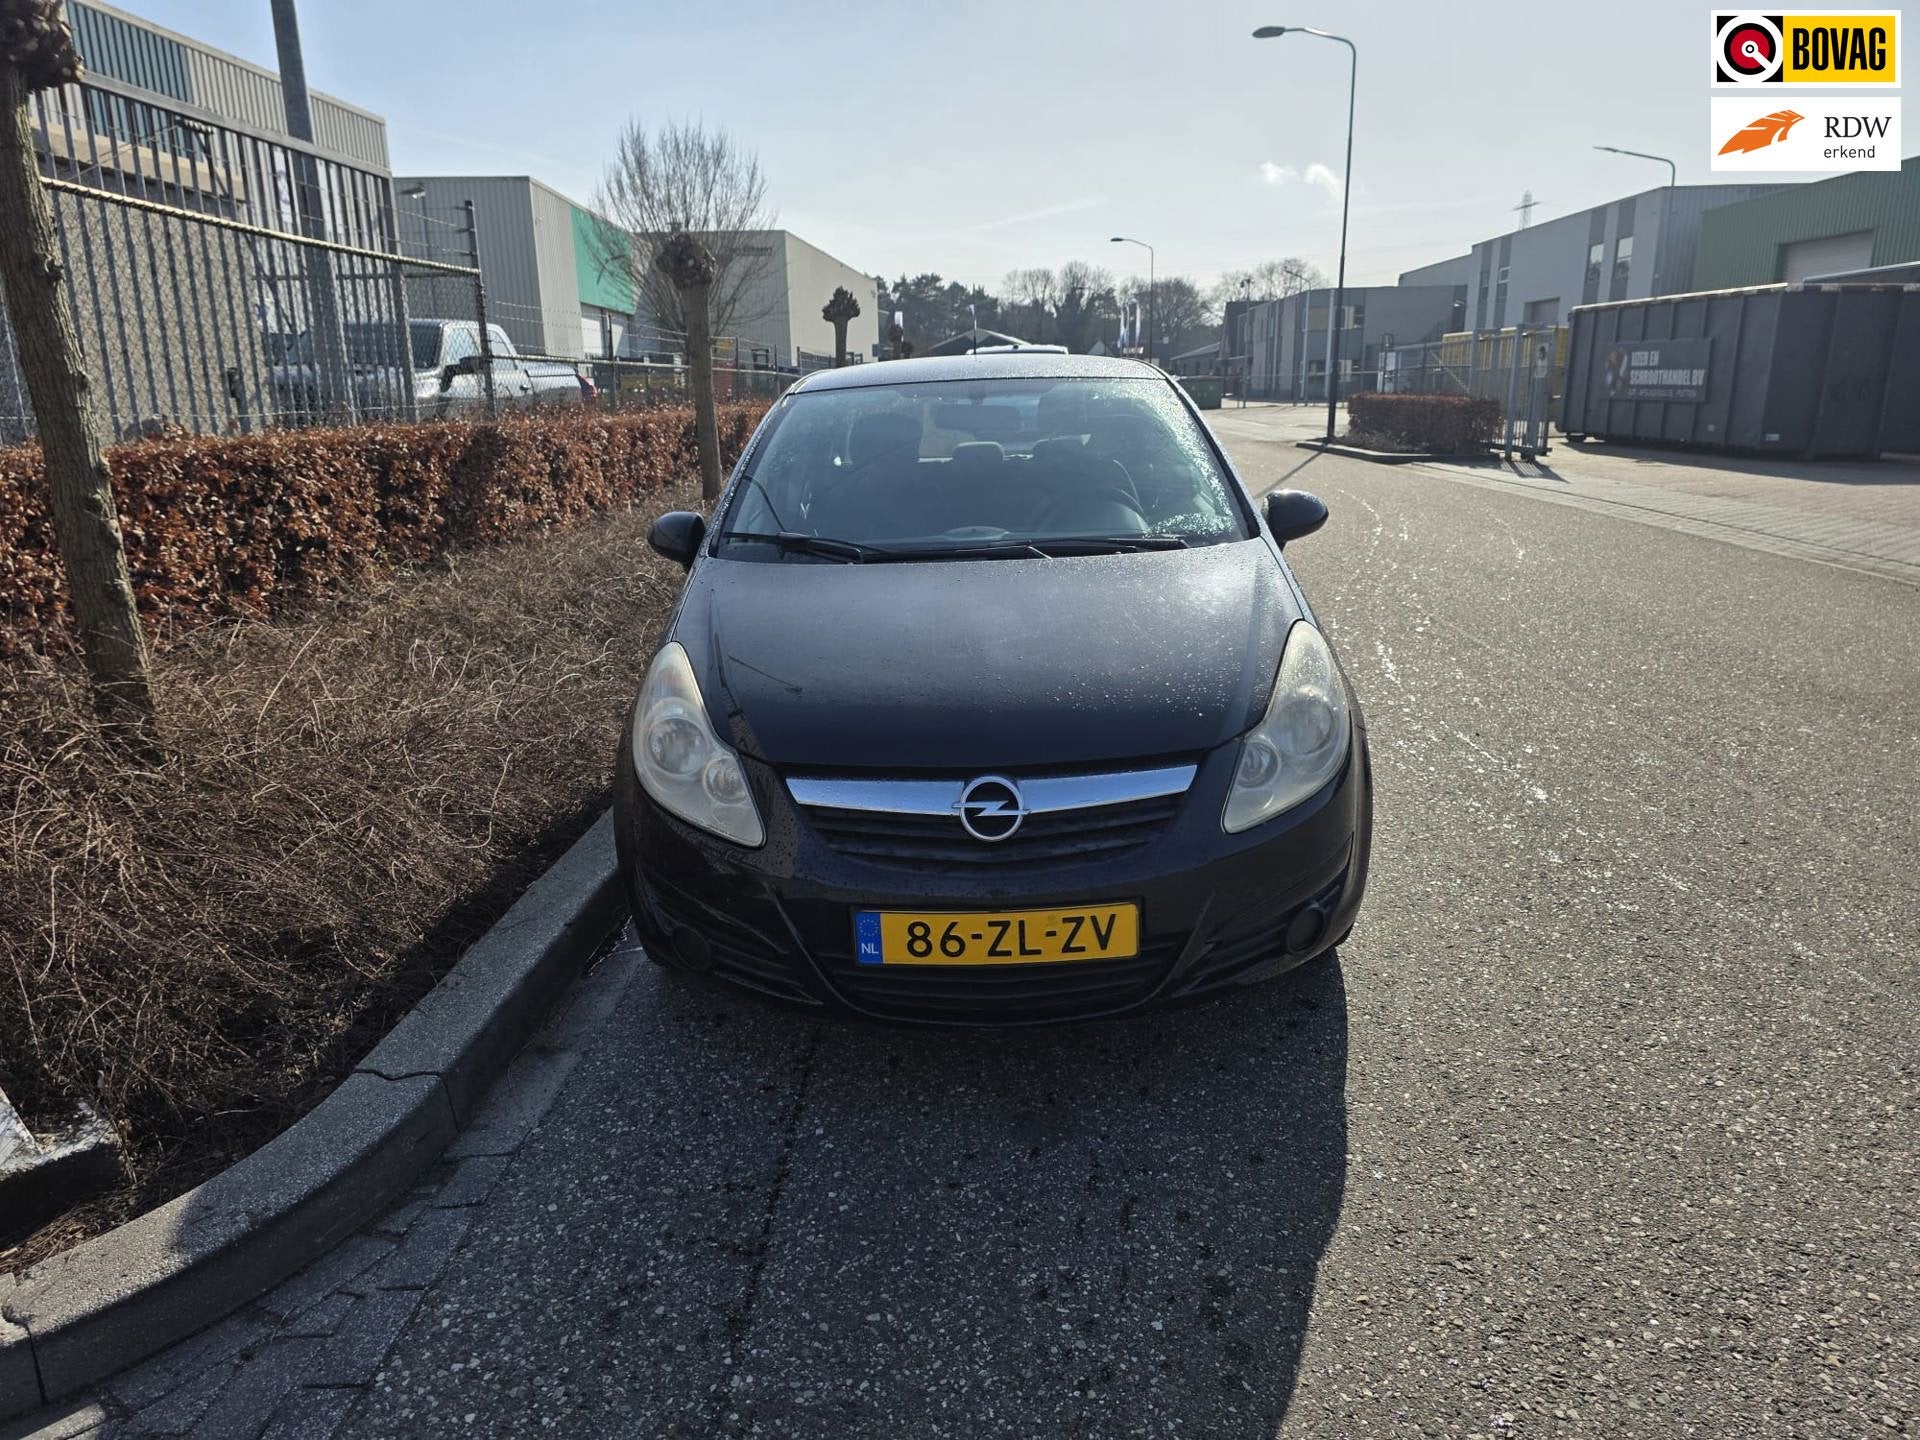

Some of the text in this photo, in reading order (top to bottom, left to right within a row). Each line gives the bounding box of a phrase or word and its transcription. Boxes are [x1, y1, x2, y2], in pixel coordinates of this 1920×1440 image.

[1649, 351, 1660, 366] EN
[1630, 369, 1705, 386] SCHROOTHANDEL BV
[906, 913, 1117, 958] 86-ZL-ZV
[860, 942, 879, 955] NL
